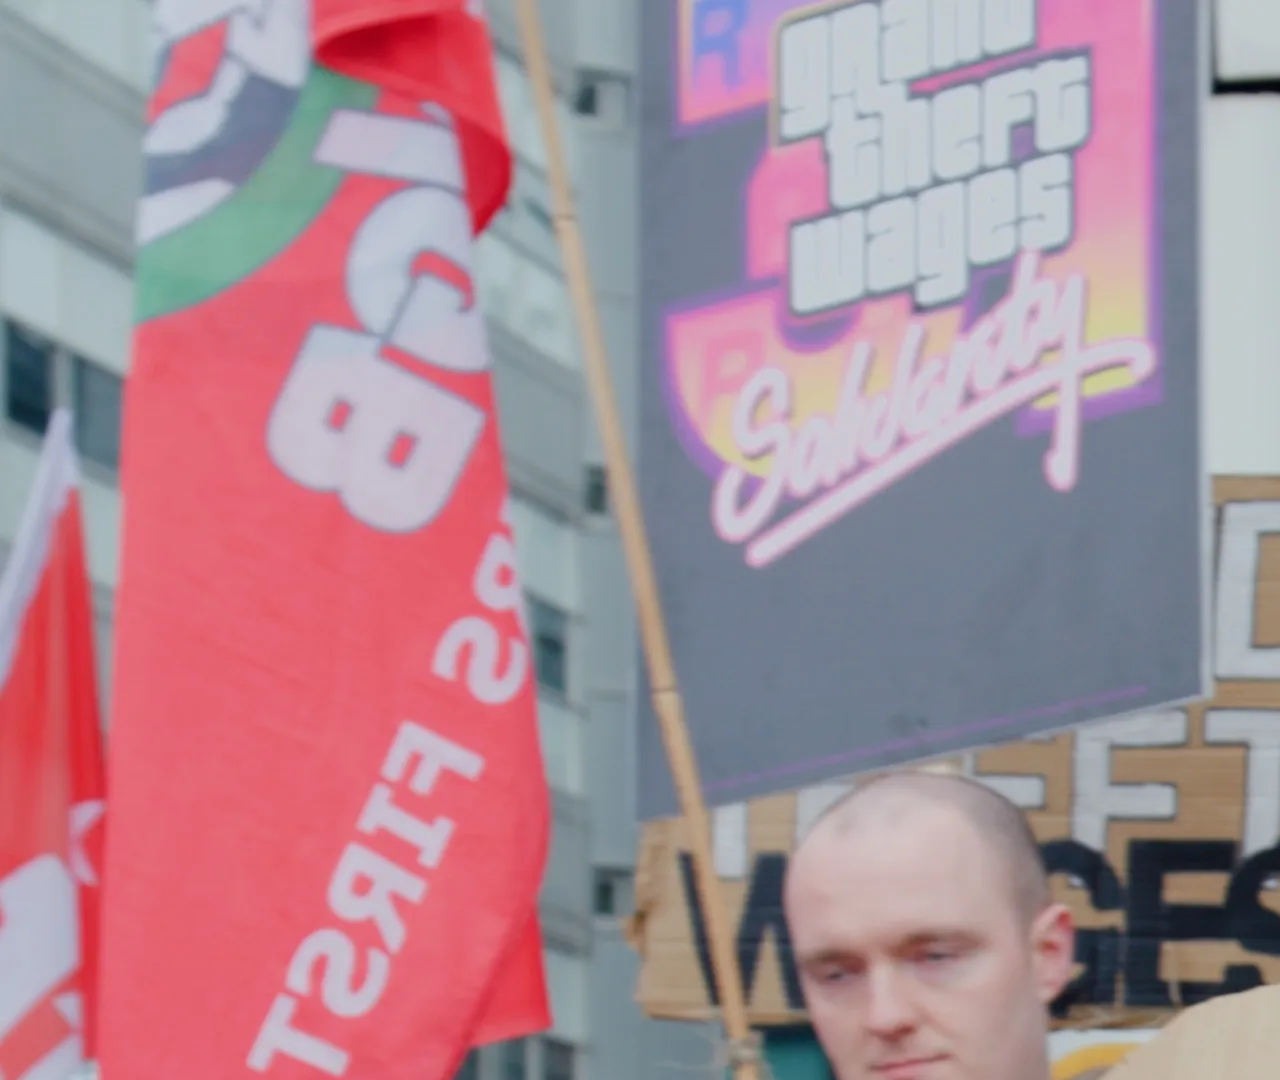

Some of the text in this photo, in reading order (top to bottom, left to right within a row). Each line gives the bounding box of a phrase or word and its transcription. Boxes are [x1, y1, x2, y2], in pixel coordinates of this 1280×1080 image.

[829, 54, 1090, 208] theft
[791, 153, 1074, 313] wages
[712, 250, 1156, 567] Solidarity
